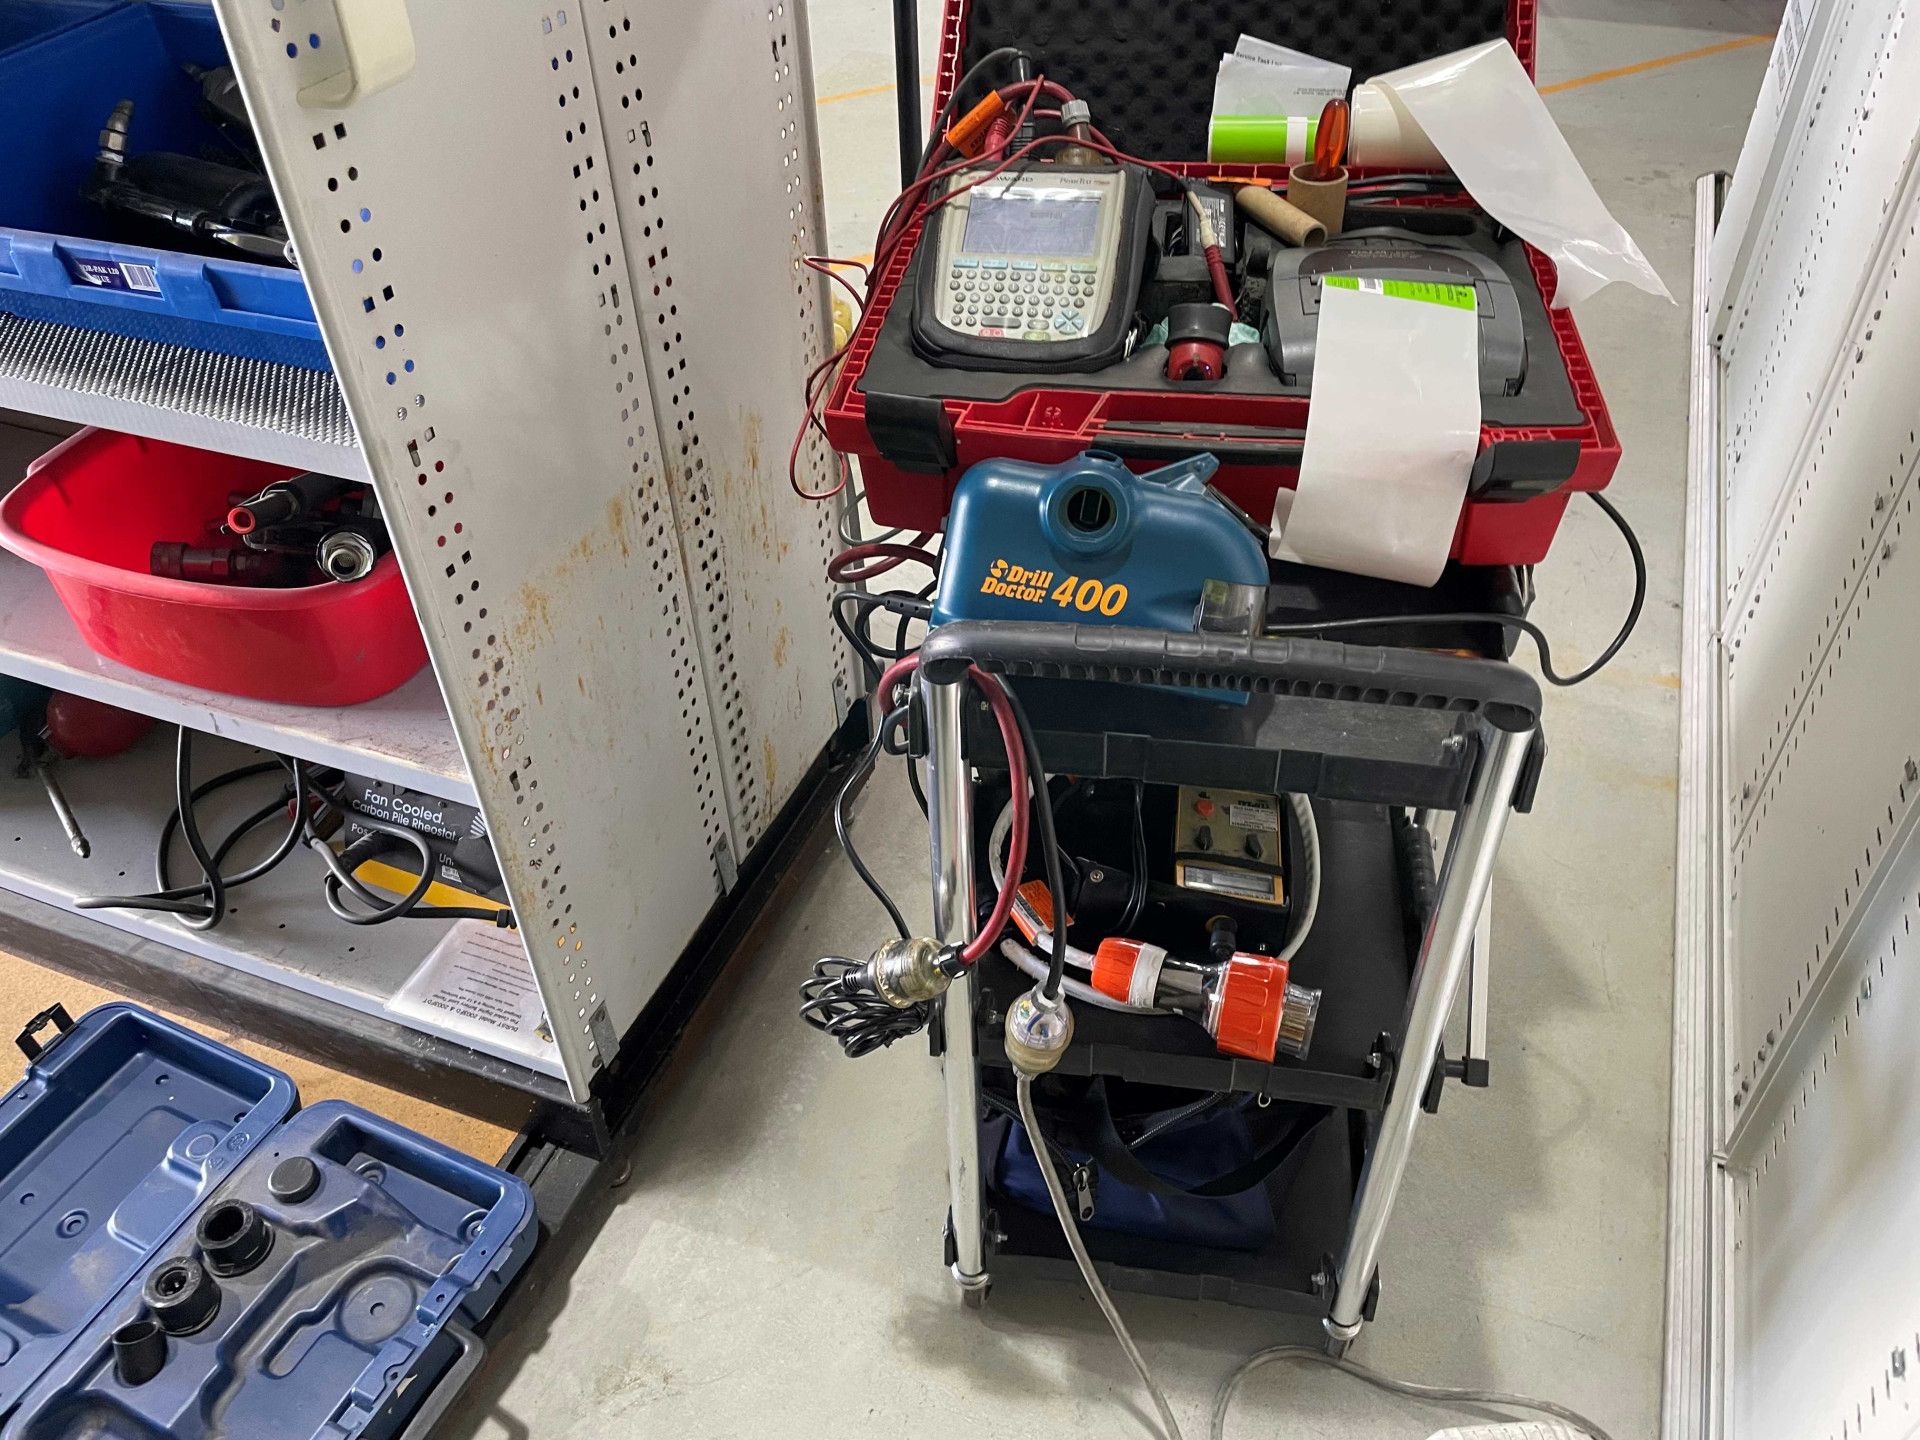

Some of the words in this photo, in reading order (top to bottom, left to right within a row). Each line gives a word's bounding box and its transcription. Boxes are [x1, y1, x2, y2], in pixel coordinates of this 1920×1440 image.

[1006, 565, 1055, 589] Drill
[1051, 575, 1129, 617] 400
[364, 788, 389, 808] Fan
[352, 799, 390, 821] Carbon
[391, 811, 410, 826] Pile
